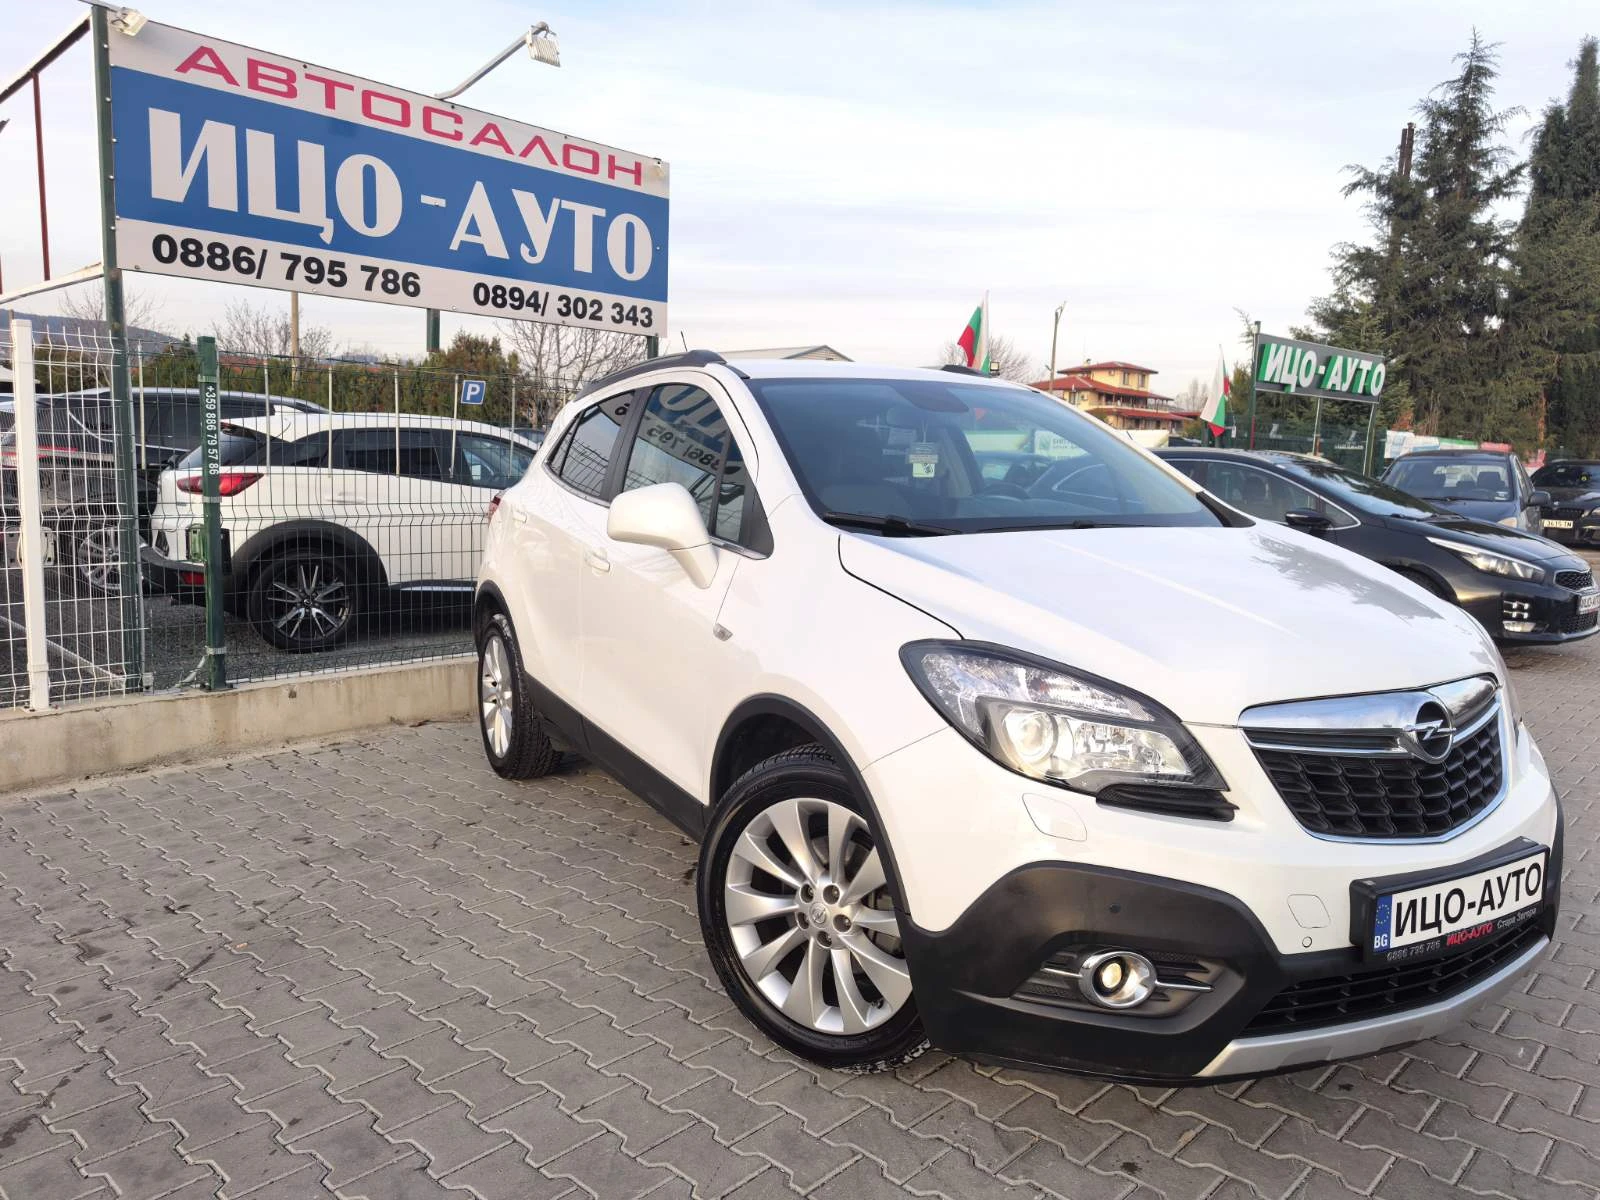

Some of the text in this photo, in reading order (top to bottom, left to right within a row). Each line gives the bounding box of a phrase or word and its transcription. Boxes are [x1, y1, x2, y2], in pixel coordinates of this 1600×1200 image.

[175, 45, 643, 187] АВТОСАЛОН
[151, 233, 421, 298] 0886/ 795 786
[473, 282, 653, 328] 0894/ 302 343
[466, 383, 480, 401] P
[205, 385, 219, 475] +359 886 79 57 86
[1395, 862, 1542, 938] ИЦО-АУТО
[1374, 934, 1388, 949] BG
